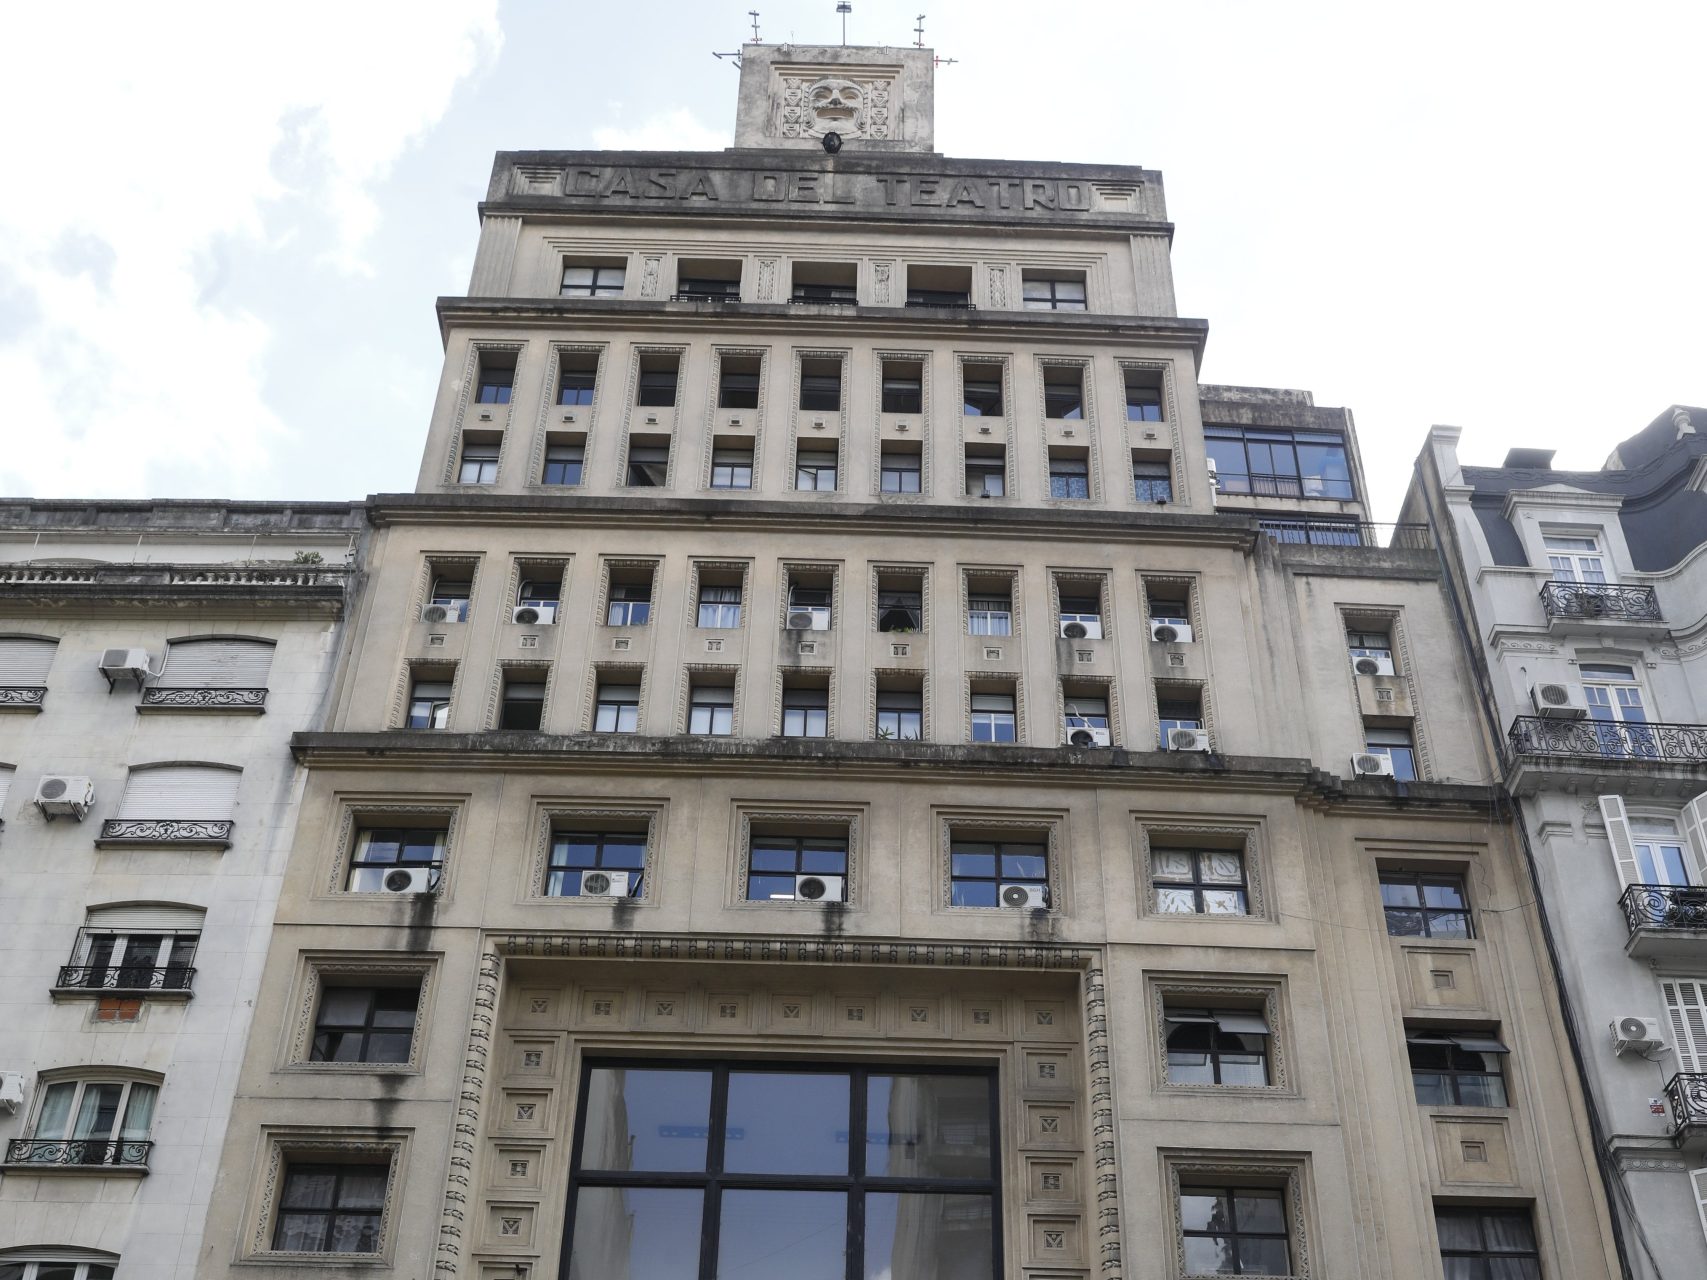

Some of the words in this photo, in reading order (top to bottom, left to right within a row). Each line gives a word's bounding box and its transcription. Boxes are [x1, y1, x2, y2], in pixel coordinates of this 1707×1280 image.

[565, 167, 718, 200] CASA
[752, 173, 855, 205] DEL
[877, 177, 1090, 211] TEATRO
